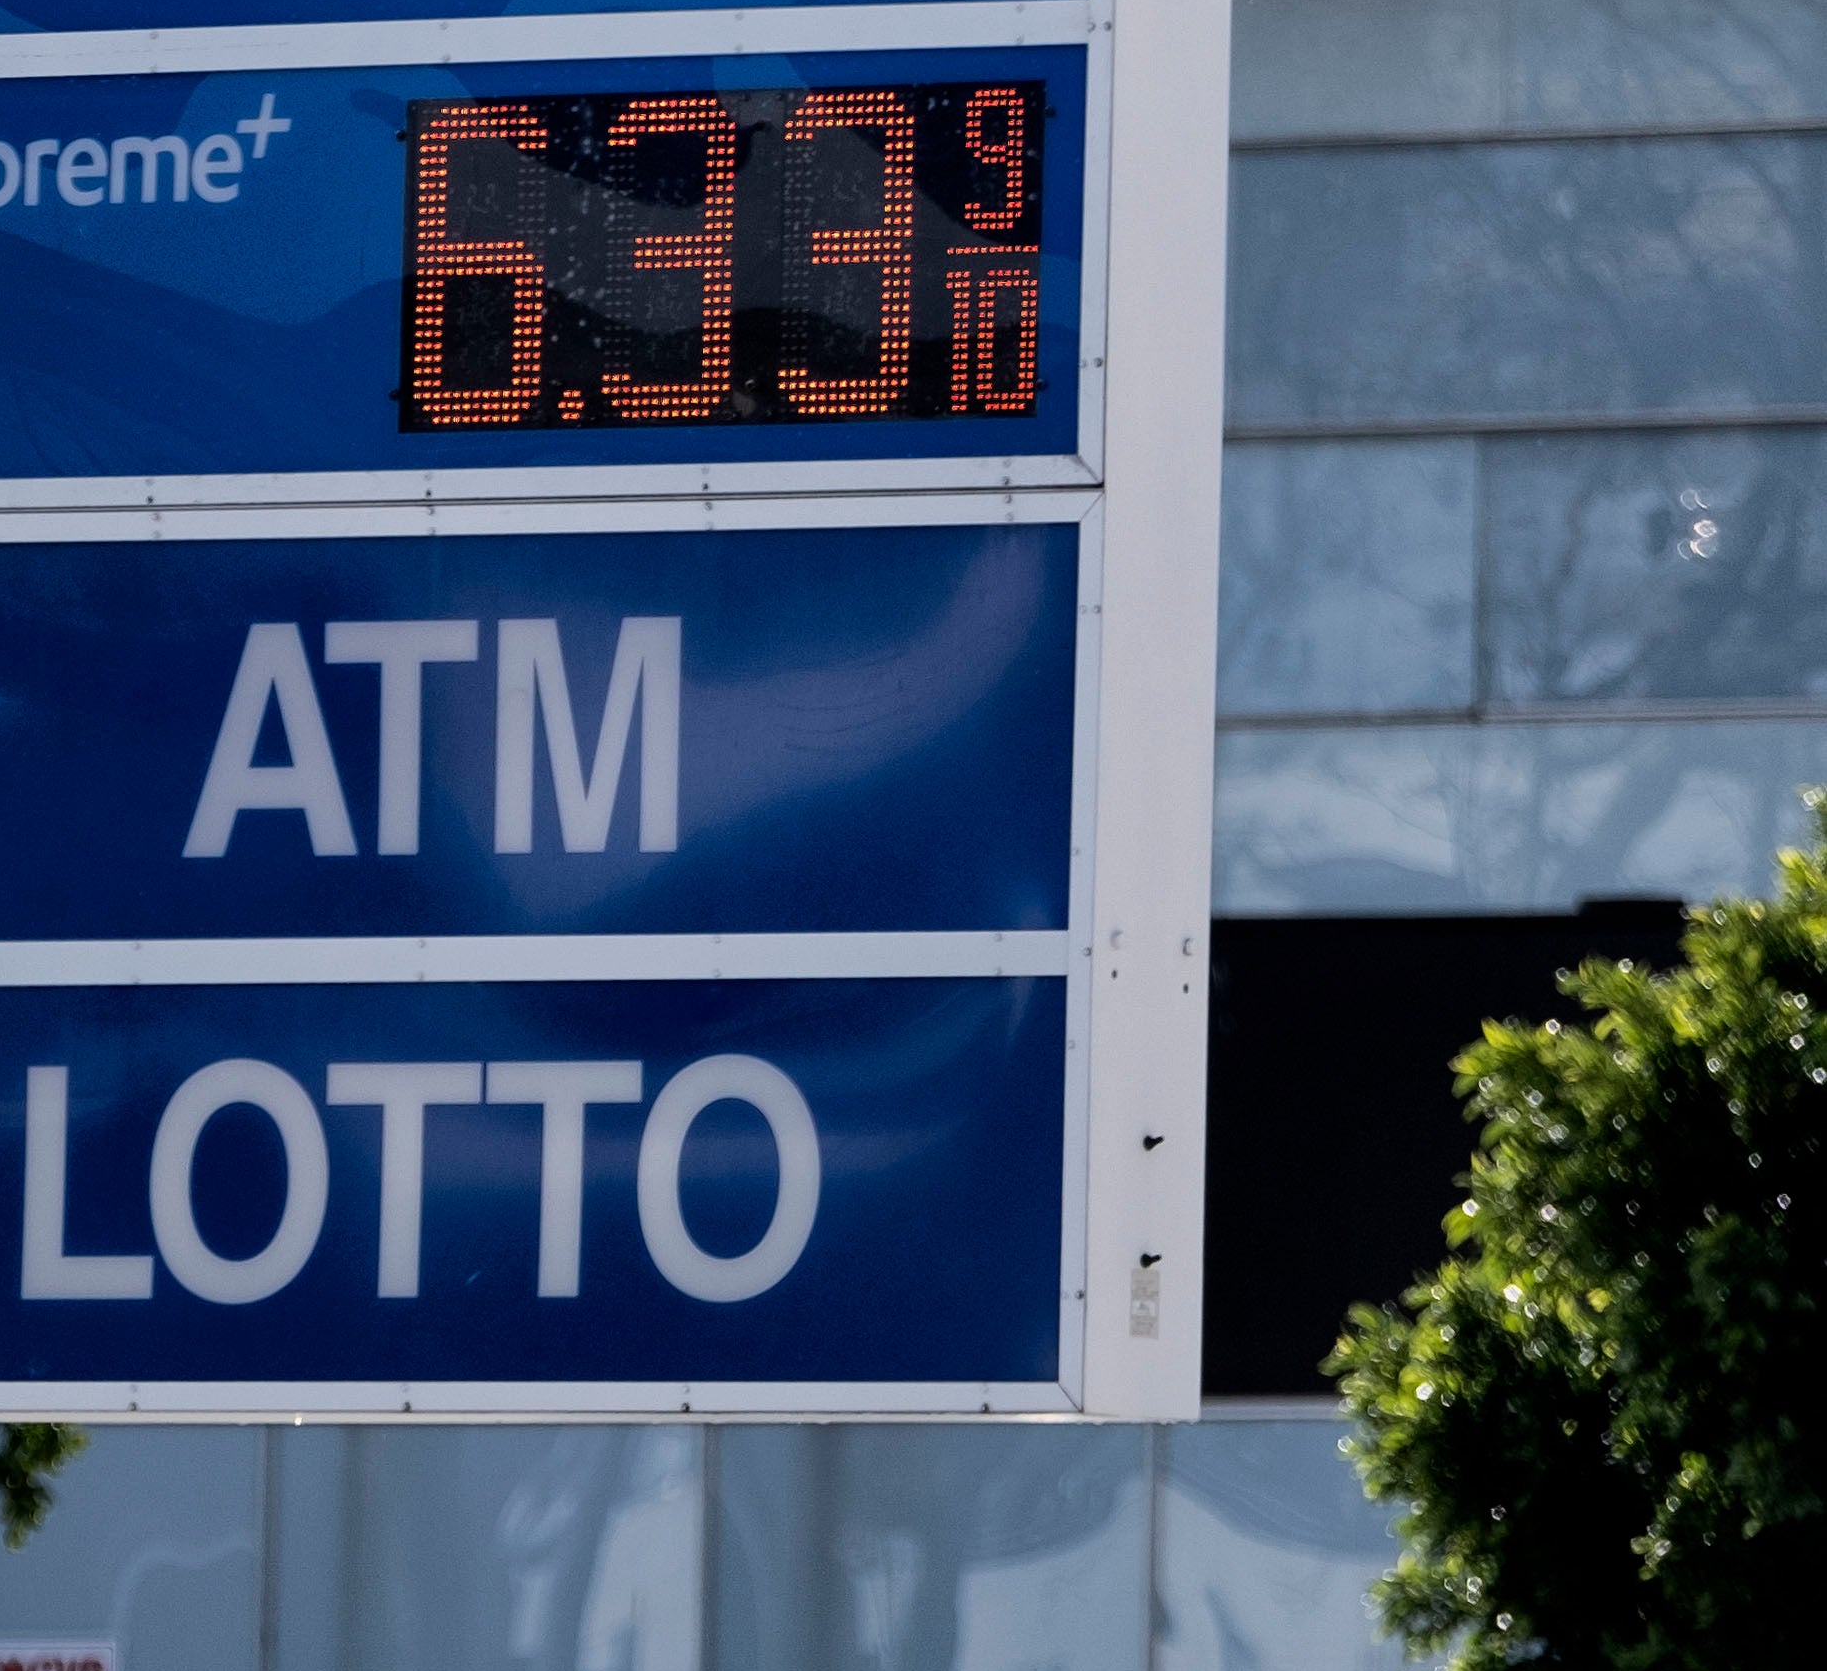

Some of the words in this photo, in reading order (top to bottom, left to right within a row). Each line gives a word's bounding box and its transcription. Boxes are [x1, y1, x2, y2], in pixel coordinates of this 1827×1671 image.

[413, 91, 915, 424] 6.33
[180, 616, 682, 859] ATM
[19, 1053, 822, 1306] LOTTO
